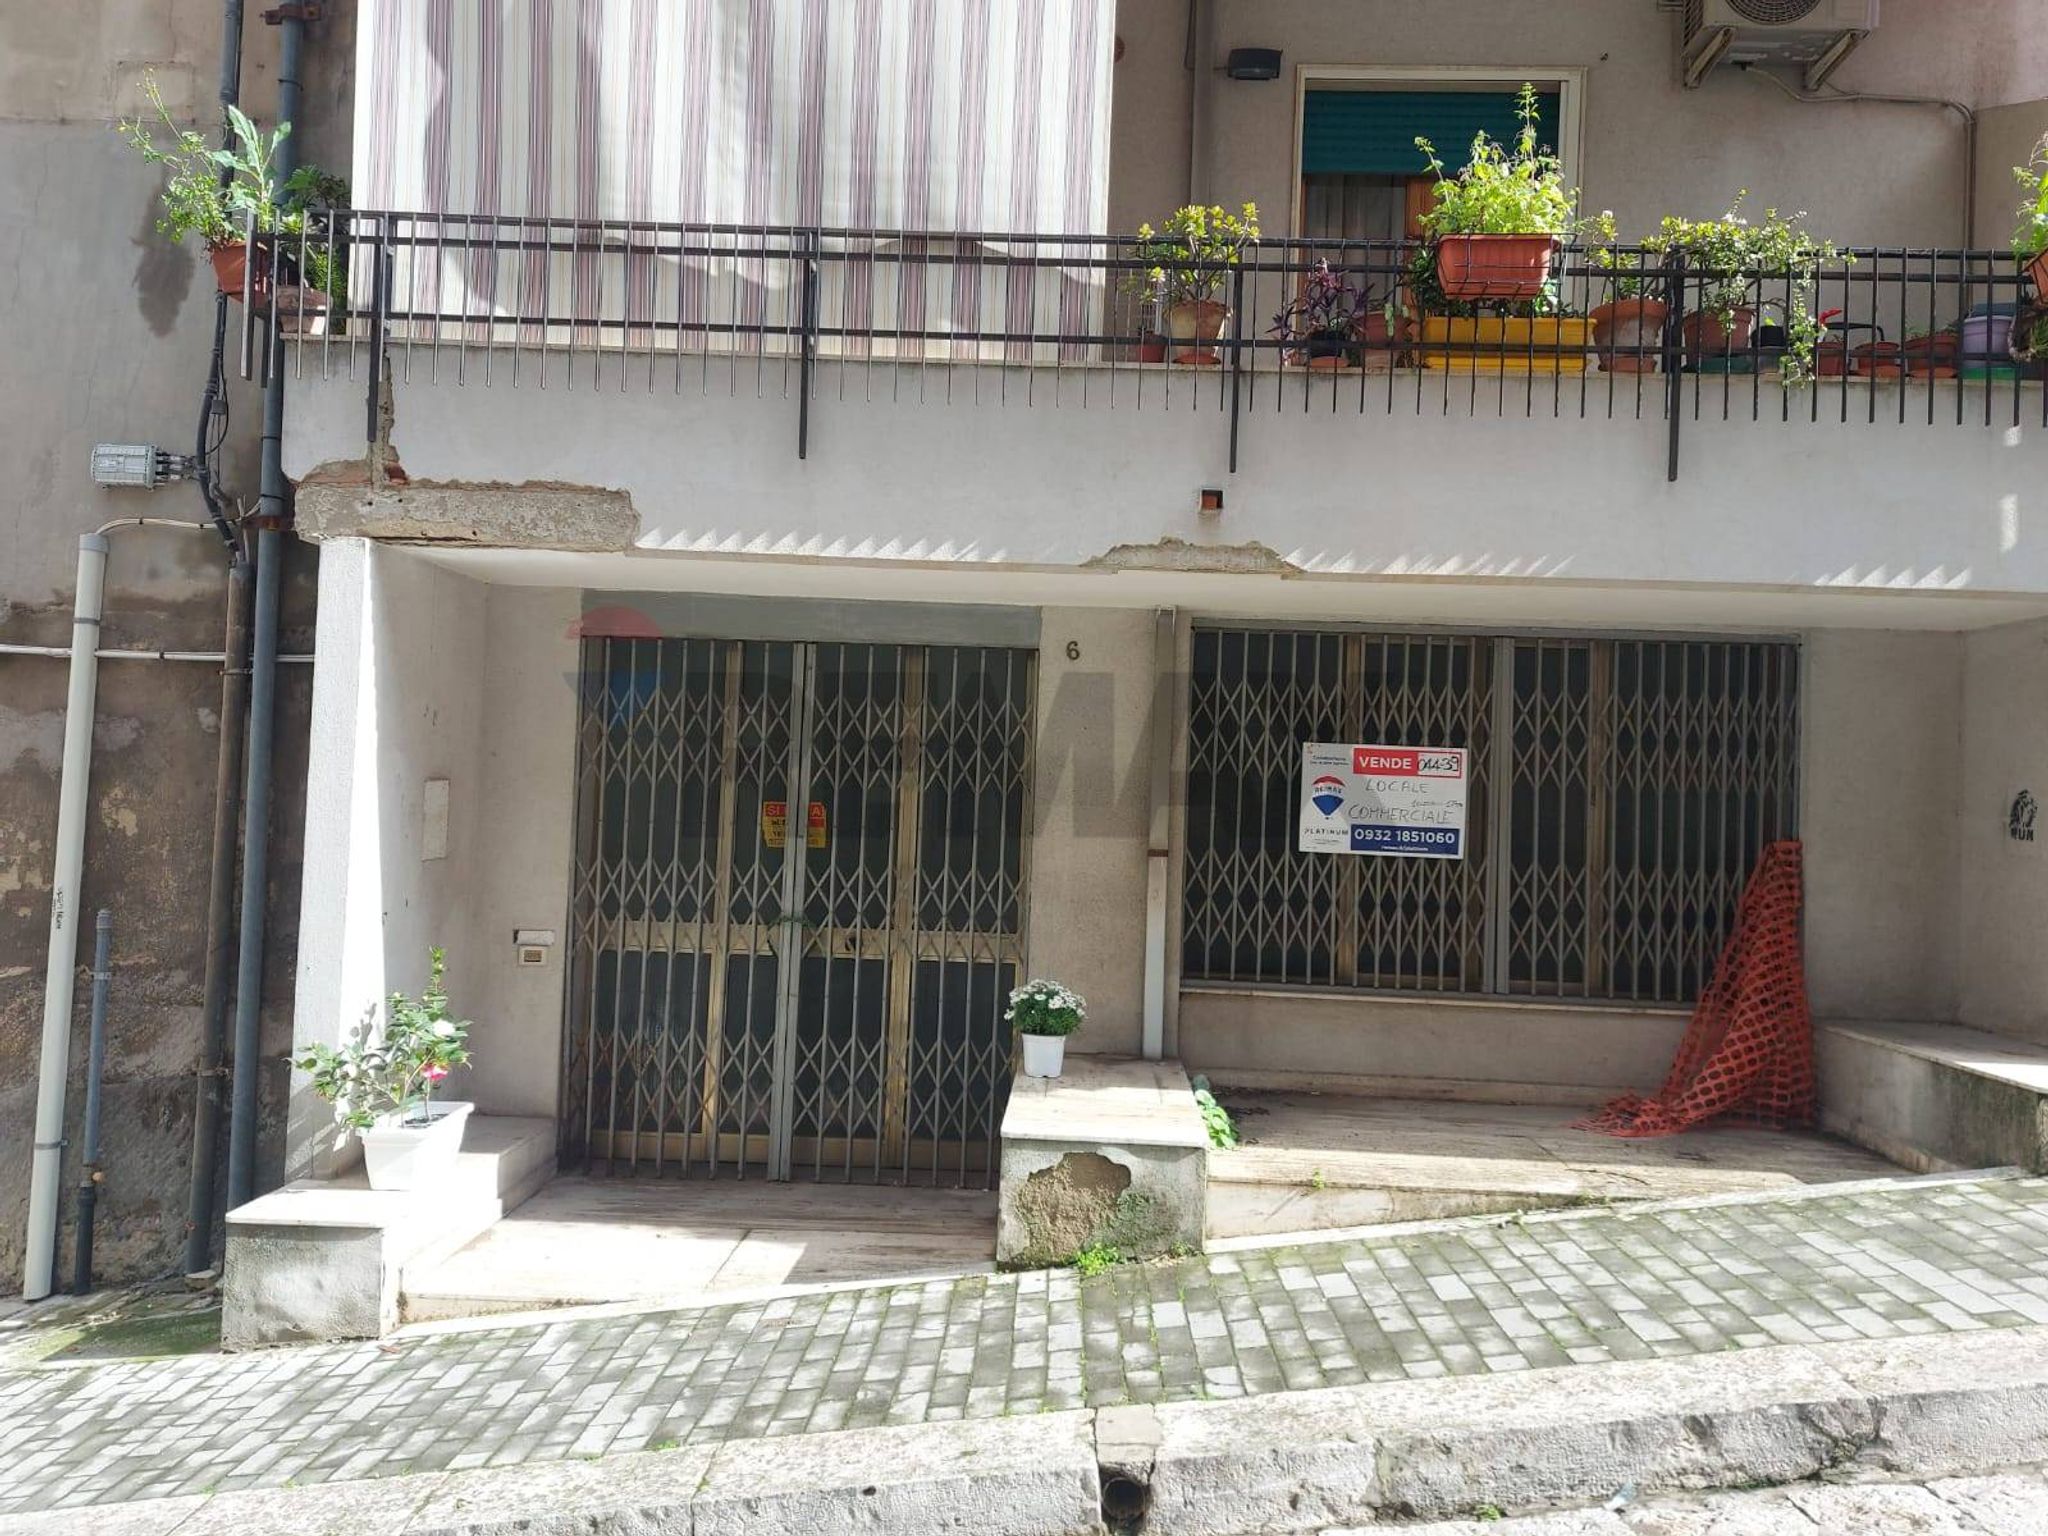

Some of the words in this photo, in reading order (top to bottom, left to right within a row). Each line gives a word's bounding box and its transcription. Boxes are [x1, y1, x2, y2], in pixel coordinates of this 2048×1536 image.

[1066, 640, 1080, 661] 6
[1359, 756, 1412, 770] VENDE
[1365, 778, 1430, 794] LOCALE
[1348, 803, 1455, 825] COMMERCIALE
[1303, 828, 1349, 836] PLATINUM
[1354, 828, 1391, 841] 0932
[1397, 830, 1456, 844] 1851060
